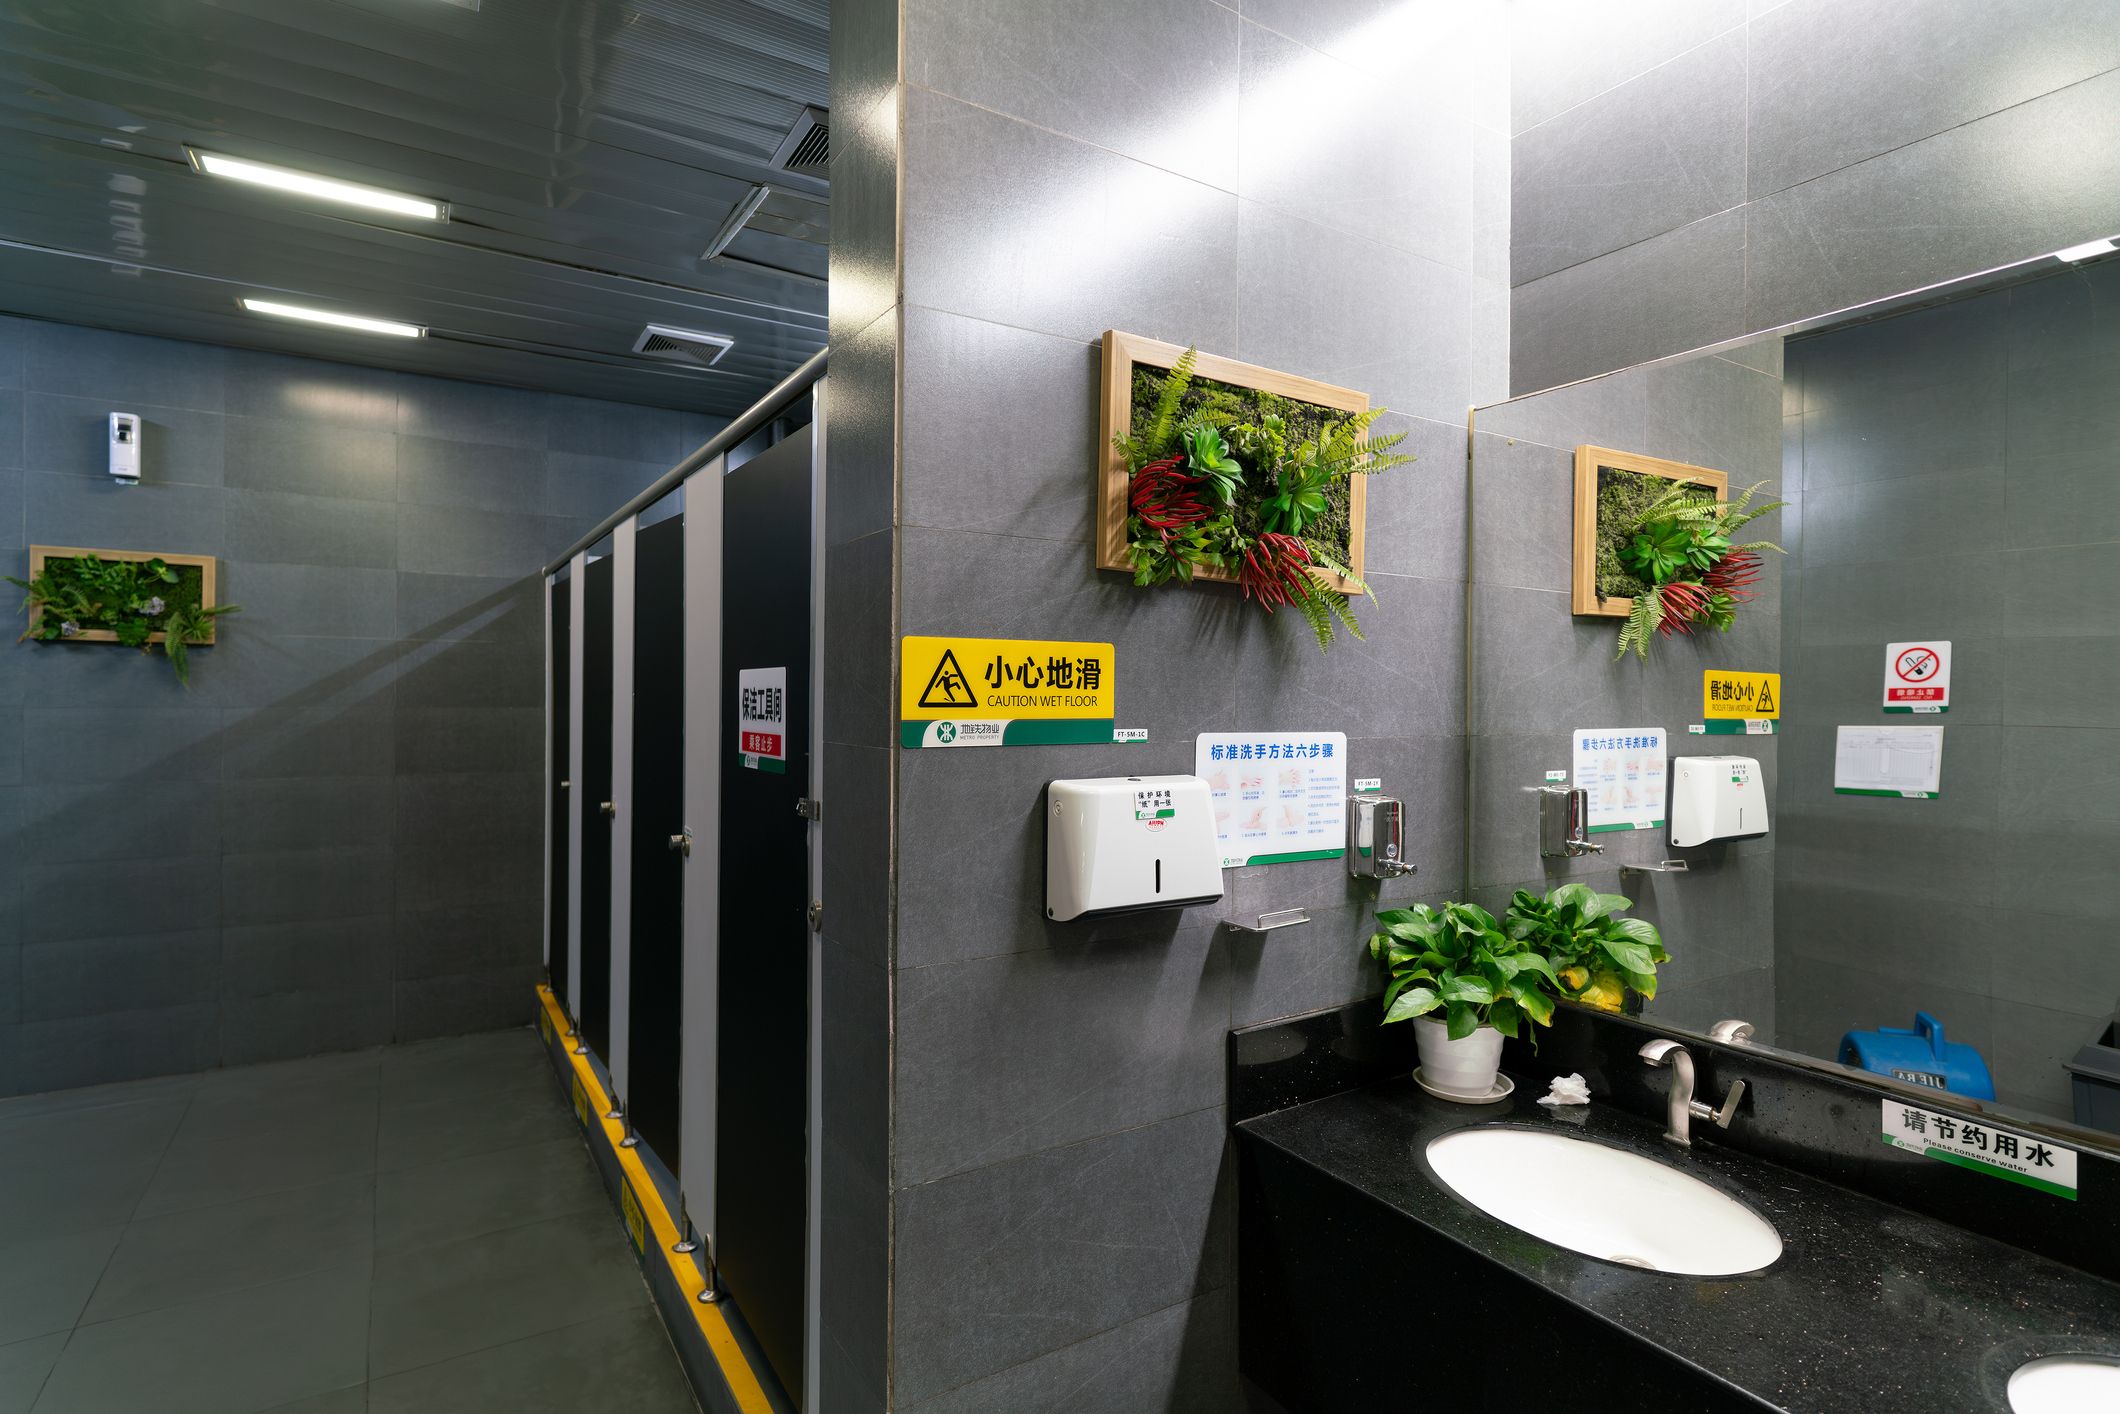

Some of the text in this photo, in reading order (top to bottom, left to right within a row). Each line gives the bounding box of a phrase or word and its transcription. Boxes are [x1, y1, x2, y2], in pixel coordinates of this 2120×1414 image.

[984, 655, 1101, 690] 小心地滑
[742, 687, 782, 723] 保洁工具间
[987, 695, 1098, 707] CAUTION WET FLOOR
[960, 724, 1000, 734] 地铁物业
[1211, 743, 1334, 761] 标准洗手方法六步骤
[1138, 790, 1171, 799] 保护环境
[1902, 1108, 2054, 1168] 请节约用水
[1923, 1137, 1953, 1152] Please
[1954, 1147, 1997, 1164] conserve
[1998, 1159, 2028, 1173] water
